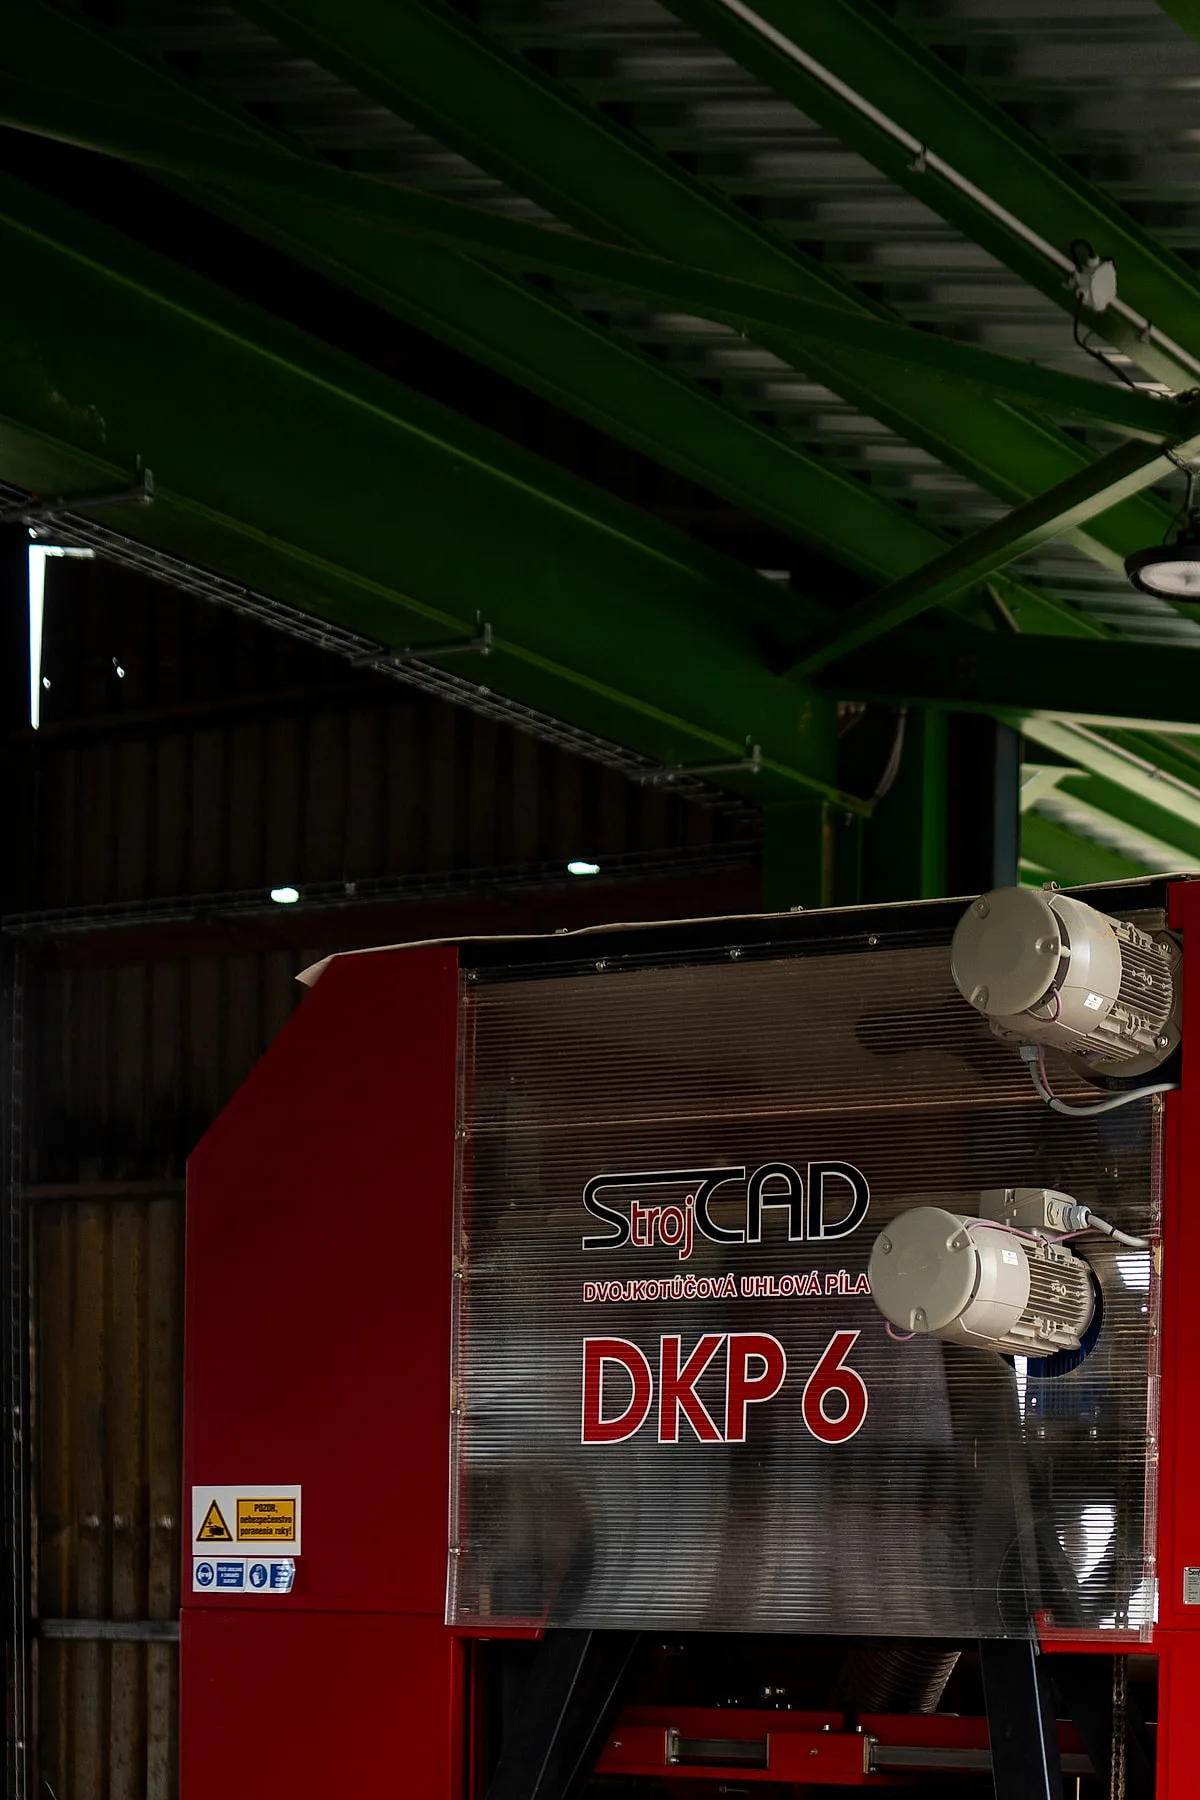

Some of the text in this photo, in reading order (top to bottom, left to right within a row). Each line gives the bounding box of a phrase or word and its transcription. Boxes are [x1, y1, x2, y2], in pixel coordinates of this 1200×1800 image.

[583, 1161, 870, 1260] StrojCAD
[583, 1269, 871, 1302] DVOJKOTÚČOVÁ UHLOVÁ PÍLA
[581, 1329, 869, 1444] DKP 6
